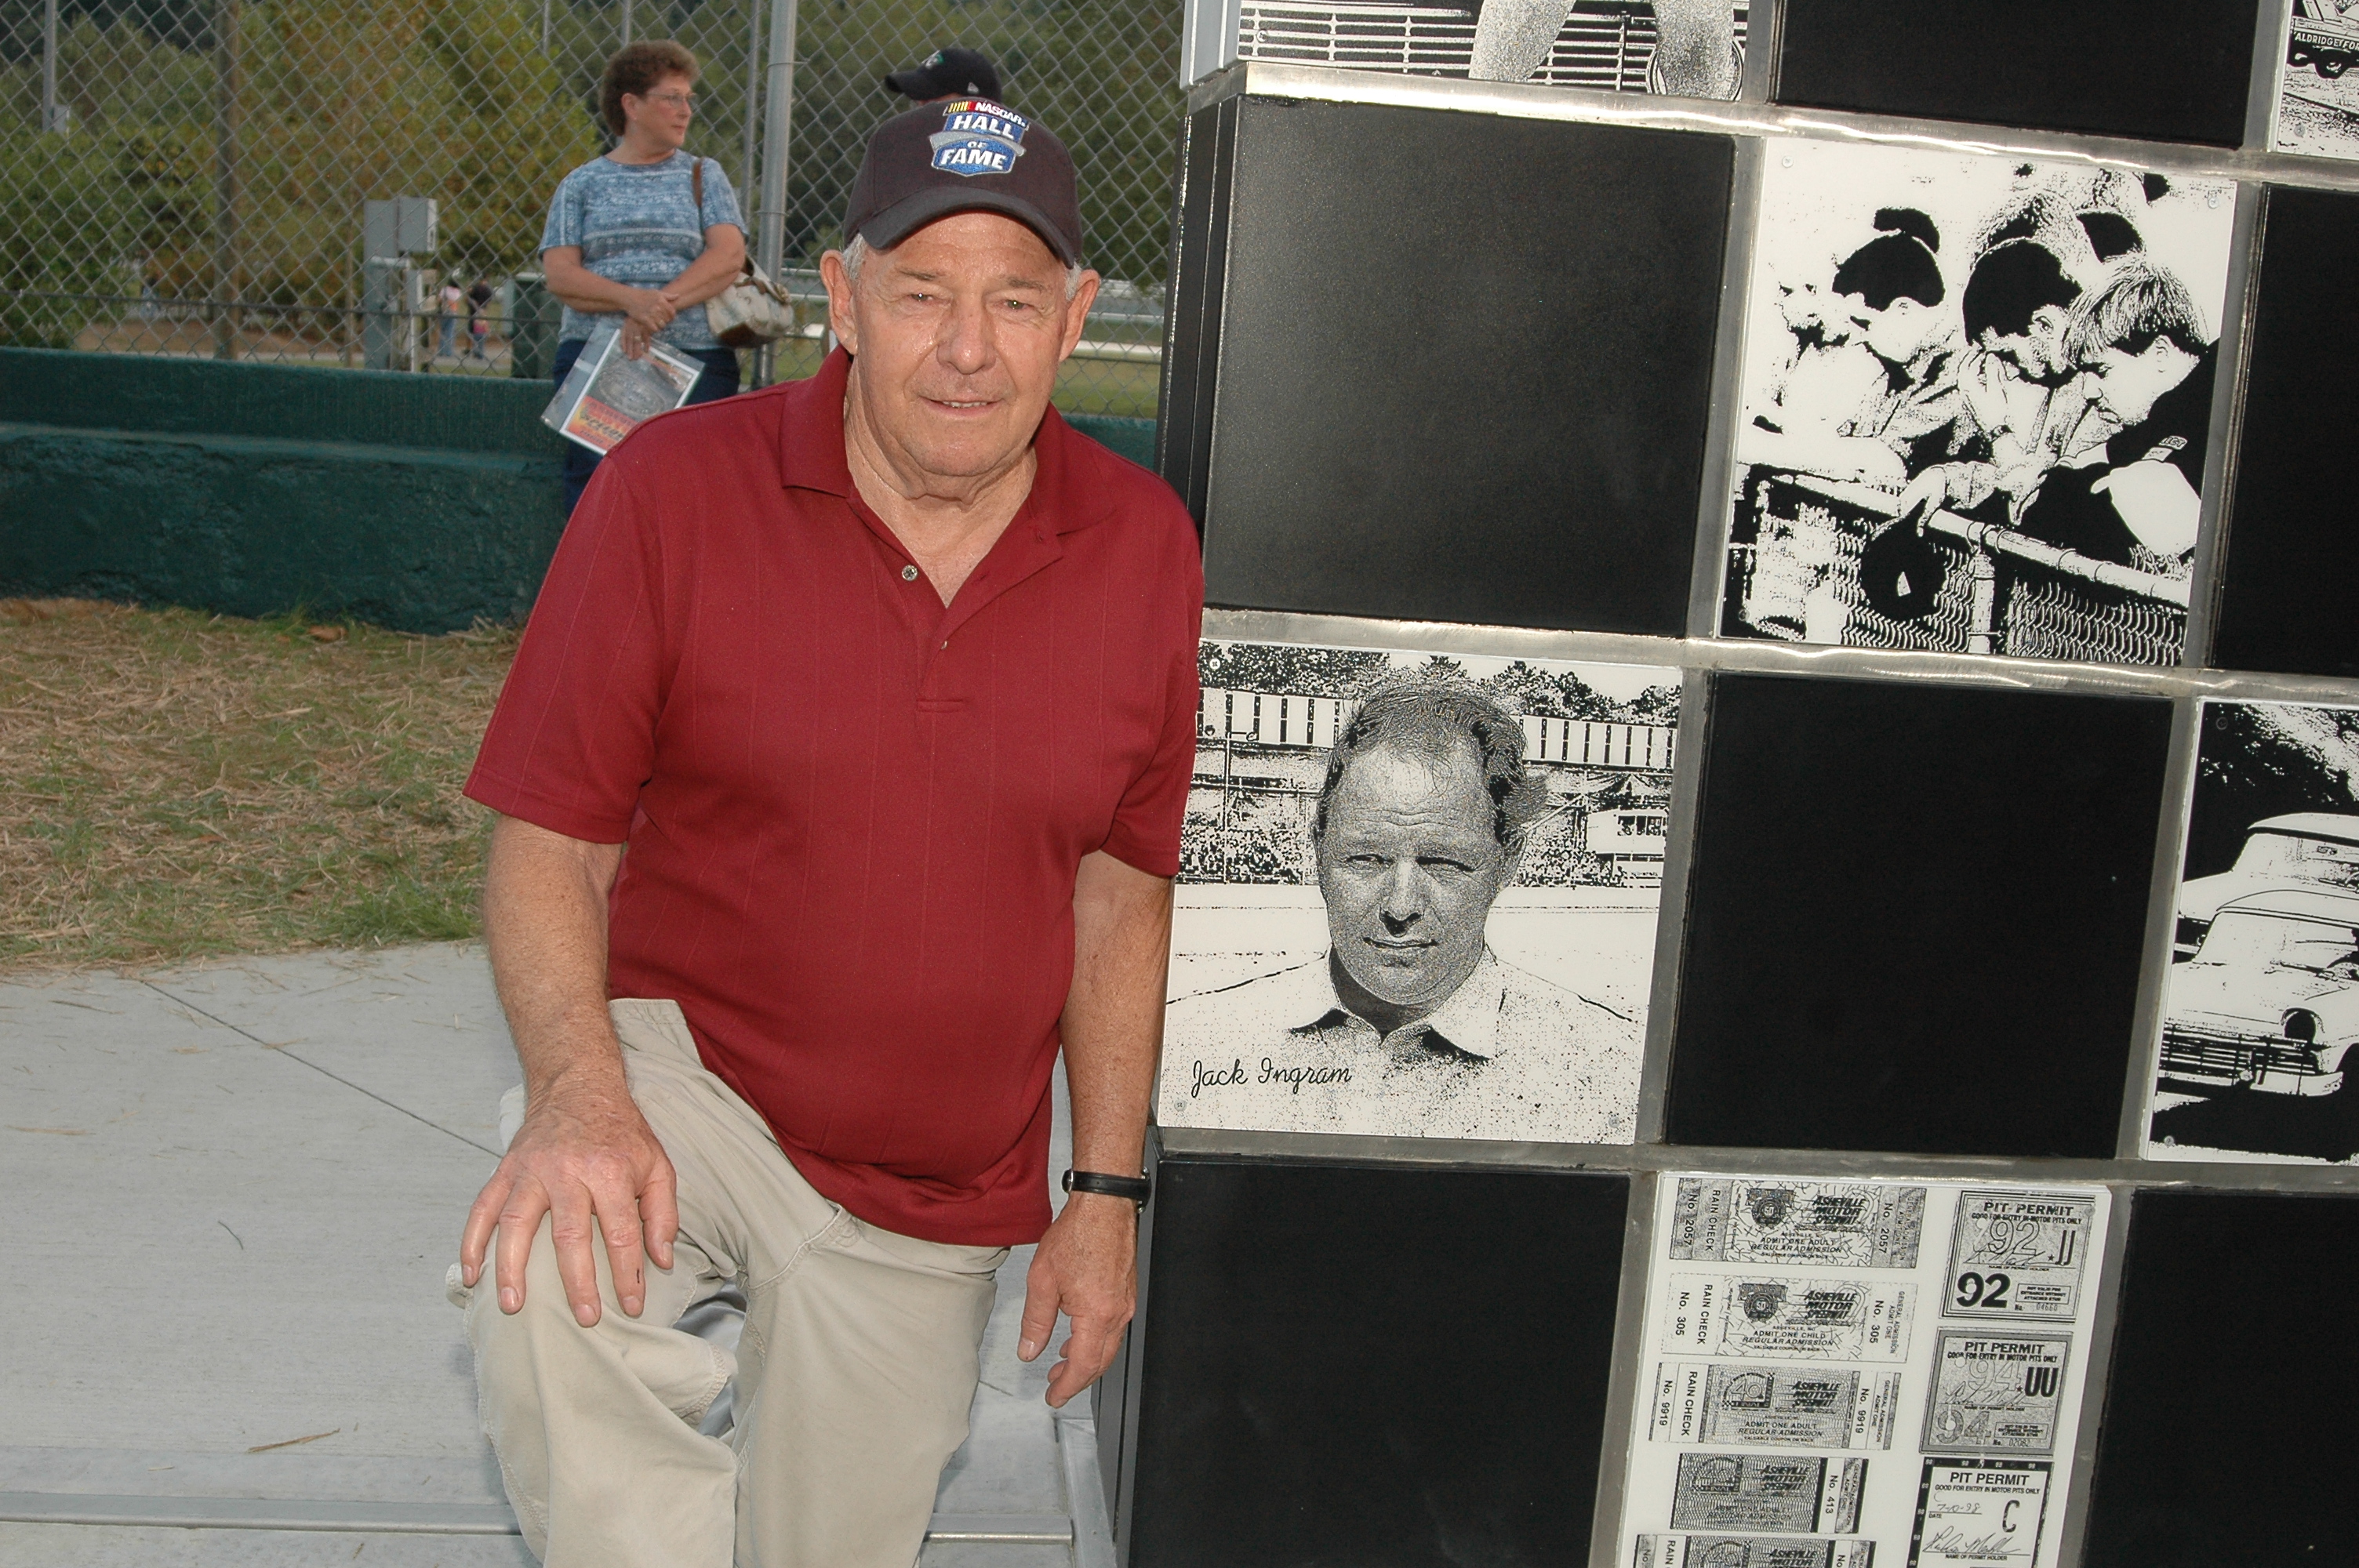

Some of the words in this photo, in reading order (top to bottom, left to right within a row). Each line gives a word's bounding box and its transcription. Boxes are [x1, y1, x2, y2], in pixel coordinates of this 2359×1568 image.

[952, 114, 1015, 140] HALL
[940, 148, 1007, 170] FAME
[1190, 1058, 1249, 1098] Jack
[1257, 1058, 1352, 1094] Ingram
[1687, 1192, 1699, 1213] No.
[1710, 1189, 1721, 1214] RAIN
[1813, 1195, 1866, 1207] ASHEVILLE
[1813, 1207, 1863, 1215] MOTOR
[1883, 1203, 1894, 1221] No.
[1983, 1202, 2009, 1213] PIT
[2016, 1203, 2074, 1216] PERMIT
[1683, 1219, 1695, 1246] 2057
[1705, 1217, 1717, 1251] CHECK
[1878, 1228, 1890, 1254] 2057
[1794, 1245, 1841, 1254] ADMISSION
[1678, 1291, 1690, 1310] No.
[1703, 1284, 1713, 1308] RAIN
[1804, 1290, 1858, 1301] ASHEVILLE
[1957, 1272, 2011, 1308] 92
[1805, 1301, 1853, 1310] MOTOR
[1873, 1300, 1884, 1318] No.
[1896, 1290, 1905, 1319] GENERAL
[1675, 1316, 1687, 1336] 305
[1696, 1311, 1710, 1345] CHECK
[1870, 1324, 1881, 1344] 305
[1965, 1341, 1988, 1352] PIT
[1991, 1342, 2045, 1355] PERMIT
[1663, 1380, 1673, 1396] No.
[1686, 1371, 1698, 1397] RAIN
[1731, 1378, 1763, 1401] 40
[1881, 1380, 1891, 1408] GENERAL
[2025, 1367, 2059, 1398] UU
[1859, 1388, 1870, 1405] No.
[1659, 1402, 1670, 1426] 9919
[1681, 1399, 1694, 1436] CHECK
[1855, 1410, 1866, 1434] 9919
[1936, 1409, 1992, 1444] 94
[1829, 1475, 1839, 1491] No.
[1950, 1472, 1972, 1483] PIT
[1976, 1473, 2030, 1486] PERMIT
[1825, 1497, 1835, 1514] 413
[2002, 1499, 2020, 1533] C
[1665, 1540, 1676, 1565] RAIN
